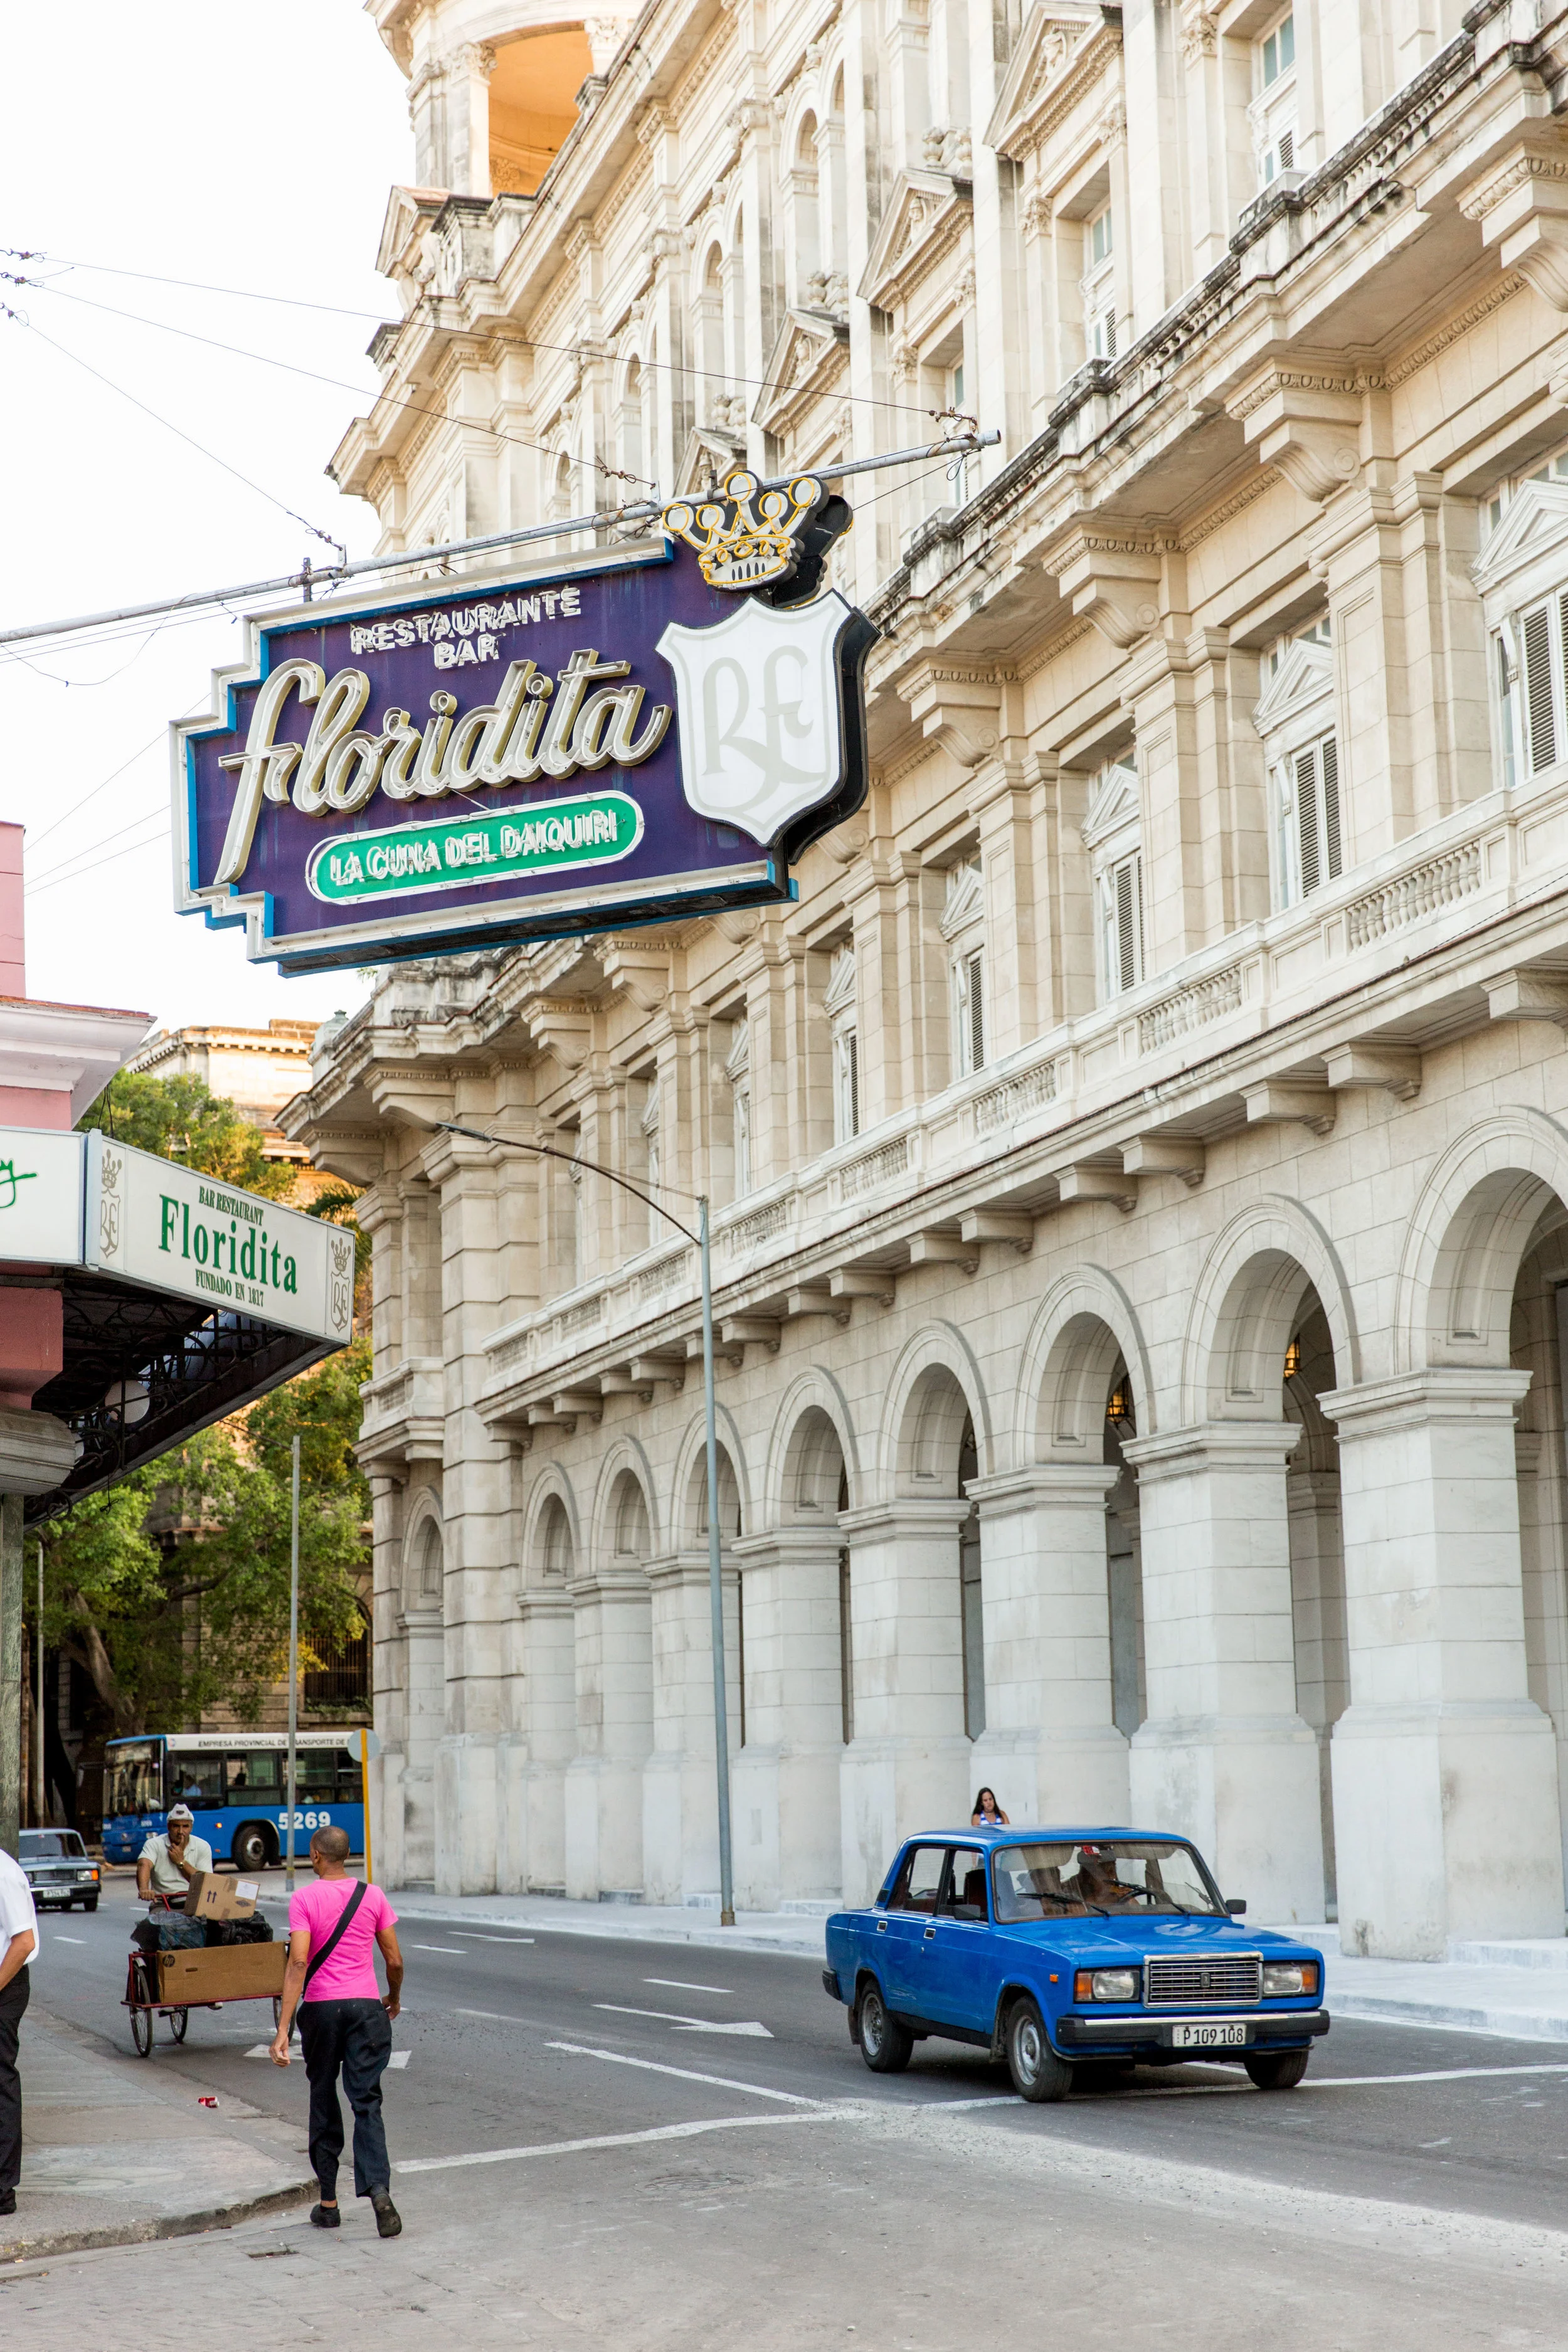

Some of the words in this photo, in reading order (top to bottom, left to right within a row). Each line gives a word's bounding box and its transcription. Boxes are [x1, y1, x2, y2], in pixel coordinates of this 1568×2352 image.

[351, 586, 581, 654] RESTAURANTE
[434, 633, 501, 670] BAR
[330, 851, 366, 886] LA
[366, 839, 442, 880] CUNA
[445, 831, 497, 868] DEL
[501, 808, 618, 859] DAIQUIRI
[199, 1185, 215, 1210] BAR
[216, 1191, 264, 1227] RESTAURANT
[158, 1193, 298, 1295] Floridita
[195, 1268, 232, 1297] FUNDADO
[235, 1281, 245, 1301] EN
[248, 1286, 264, 1308] 1817
[234, 1739, 275, 1747] PROVINCIAL
[277, 1739, 287, 1747] DE
[291, 1738, 333, 1746] RANSPORTE
[278, 1811, 331, 1830] 5269
[1184, 2029, 1190, 2045] P
[1194, 2029, 1217, 2045] 109
[1220, 2028, 1243, 2043] 108
